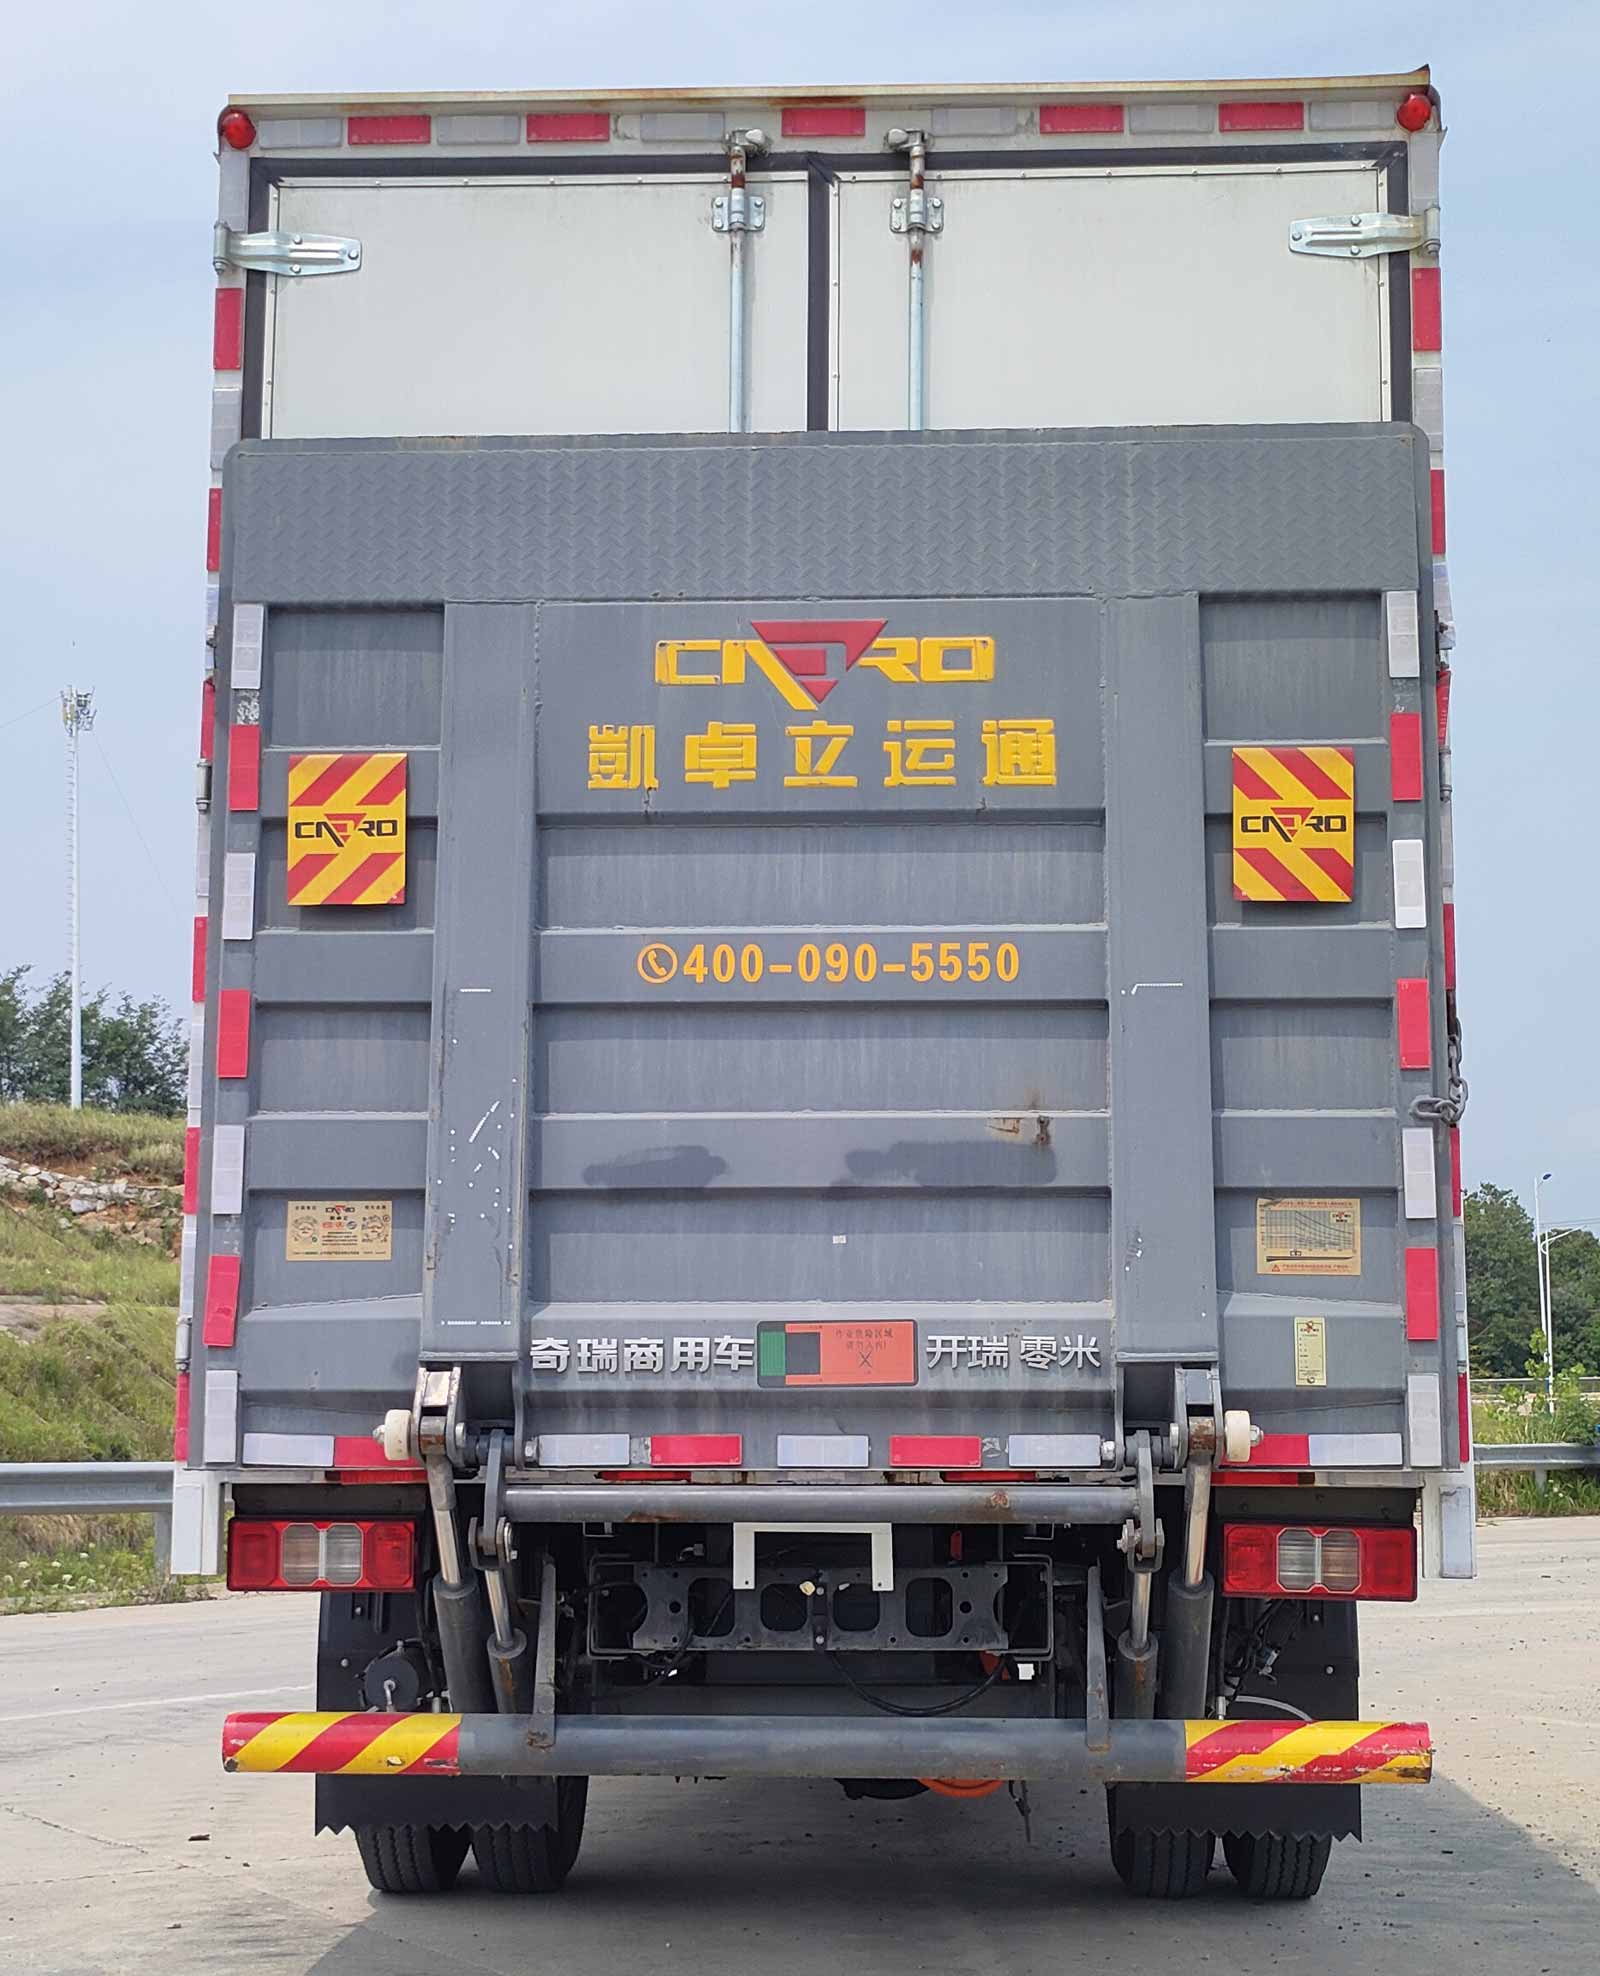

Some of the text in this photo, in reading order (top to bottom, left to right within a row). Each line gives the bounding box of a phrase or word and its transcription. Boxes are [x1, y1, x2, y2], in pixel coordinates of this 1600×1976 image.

[683, 942, 1020, 984] 400-090-5550
[529, 1335, 755, 1373] 奇瑞商用车
